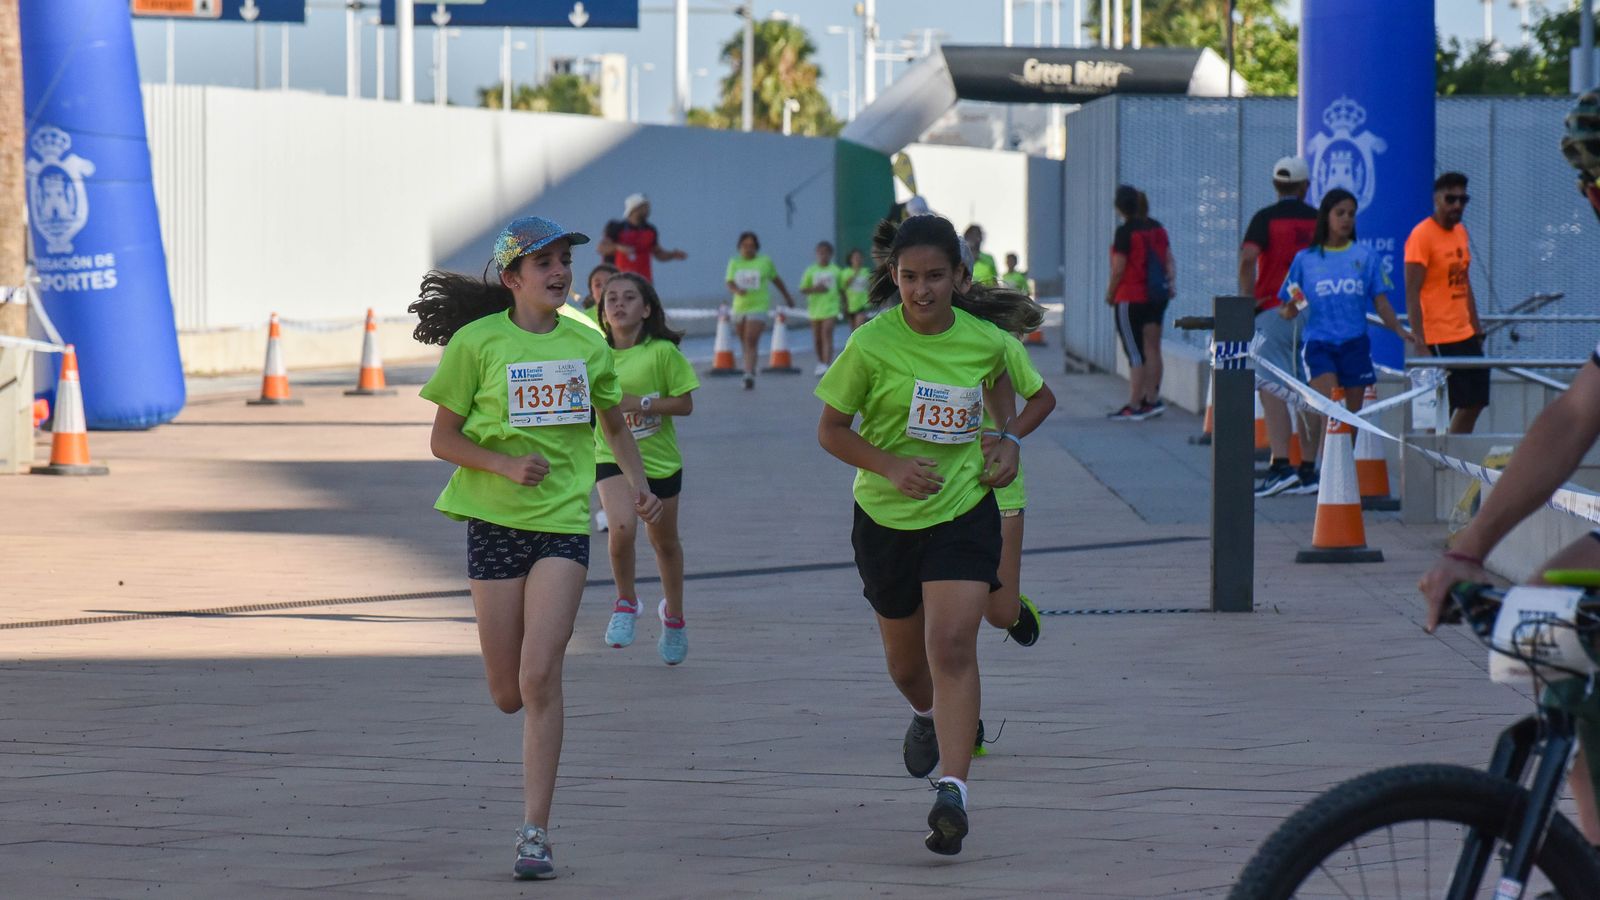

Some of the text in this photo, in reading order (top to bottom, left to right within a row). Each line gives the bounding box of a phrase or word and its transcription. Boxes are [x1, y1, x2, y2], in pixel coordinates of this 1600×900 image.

[1023, 57, 1119, 87] Green Rider
[1375, 238, 1394, 251] DE
[94, 253, 114, 268] DE
[40, 269, 117, 292] PORTES
[1315, 278, 1364, 296] EVOS
[510, 368, 527, 379] XXI
[514, 384, 567, 409] 1337
[917, 386, 933, 397] XXI
[916, 403, 968, 429] 1333
